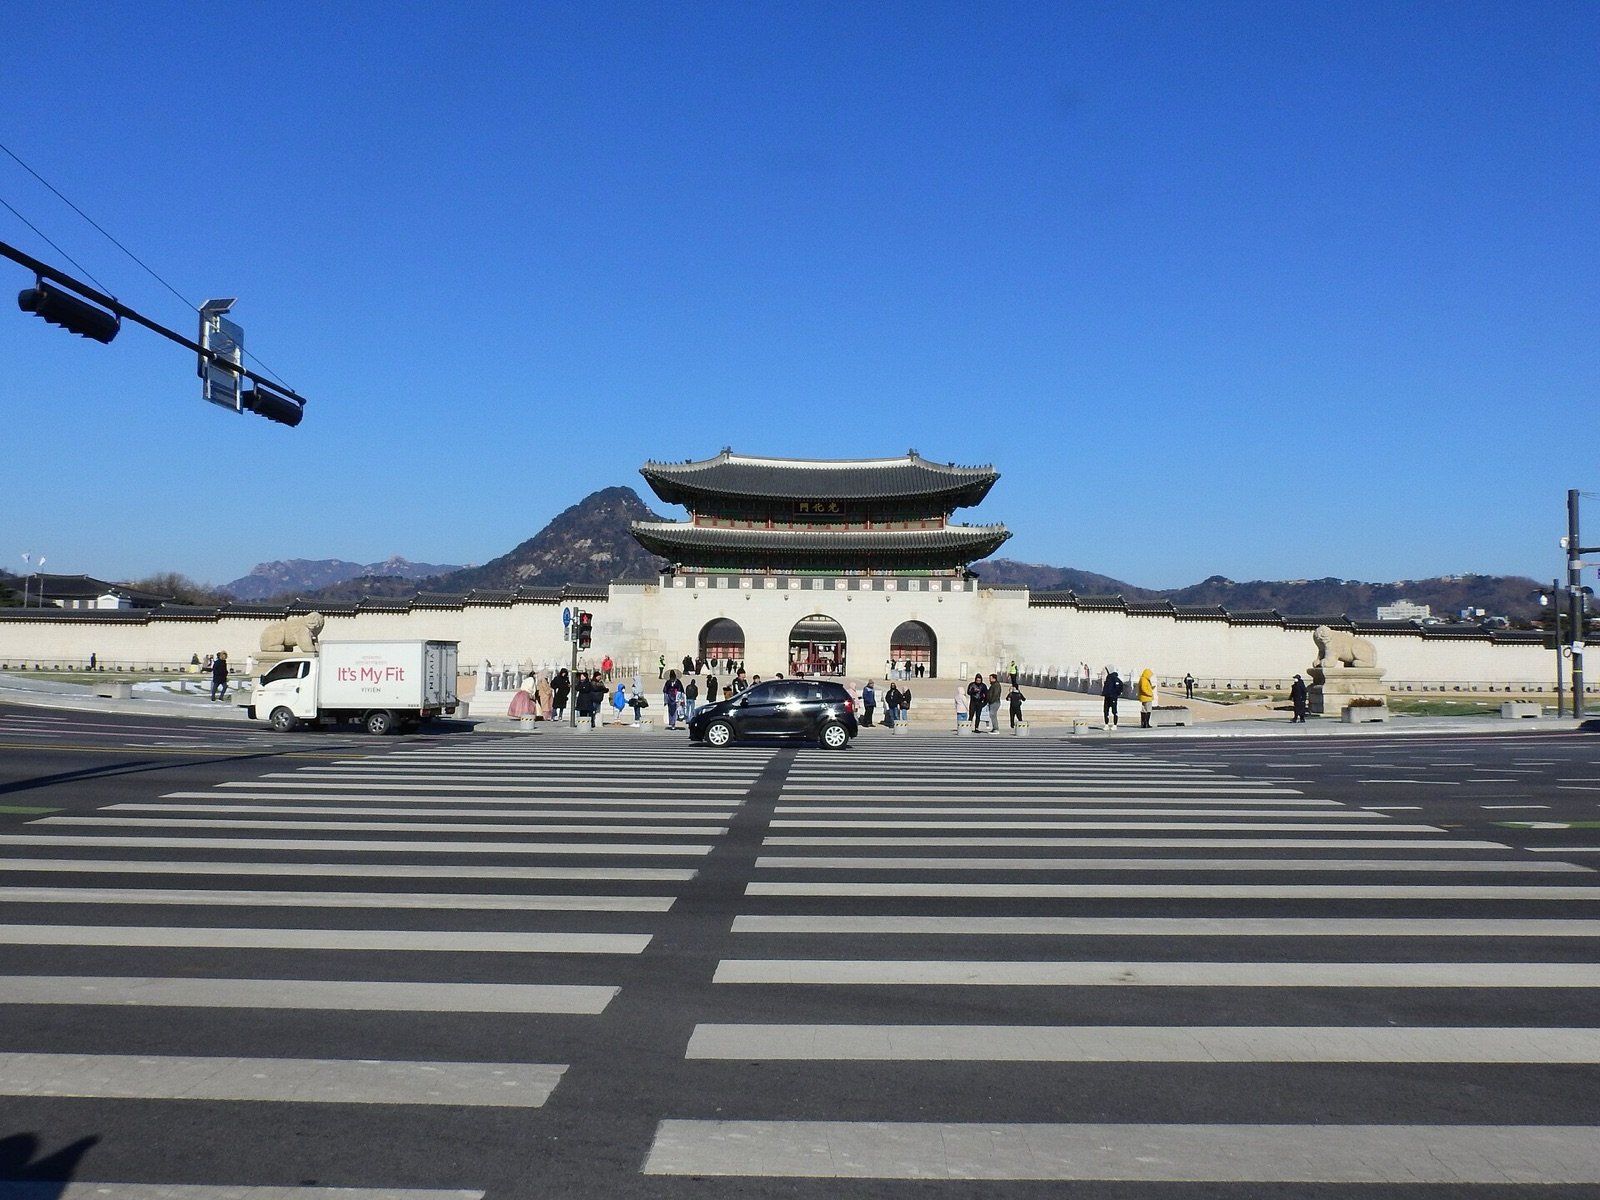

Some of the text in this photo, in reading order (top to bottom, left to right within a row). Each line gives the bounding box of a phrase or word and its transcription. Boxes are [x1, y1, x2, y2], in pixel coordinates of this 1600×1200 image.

[337, 666, 405, 685] It's My Fit
